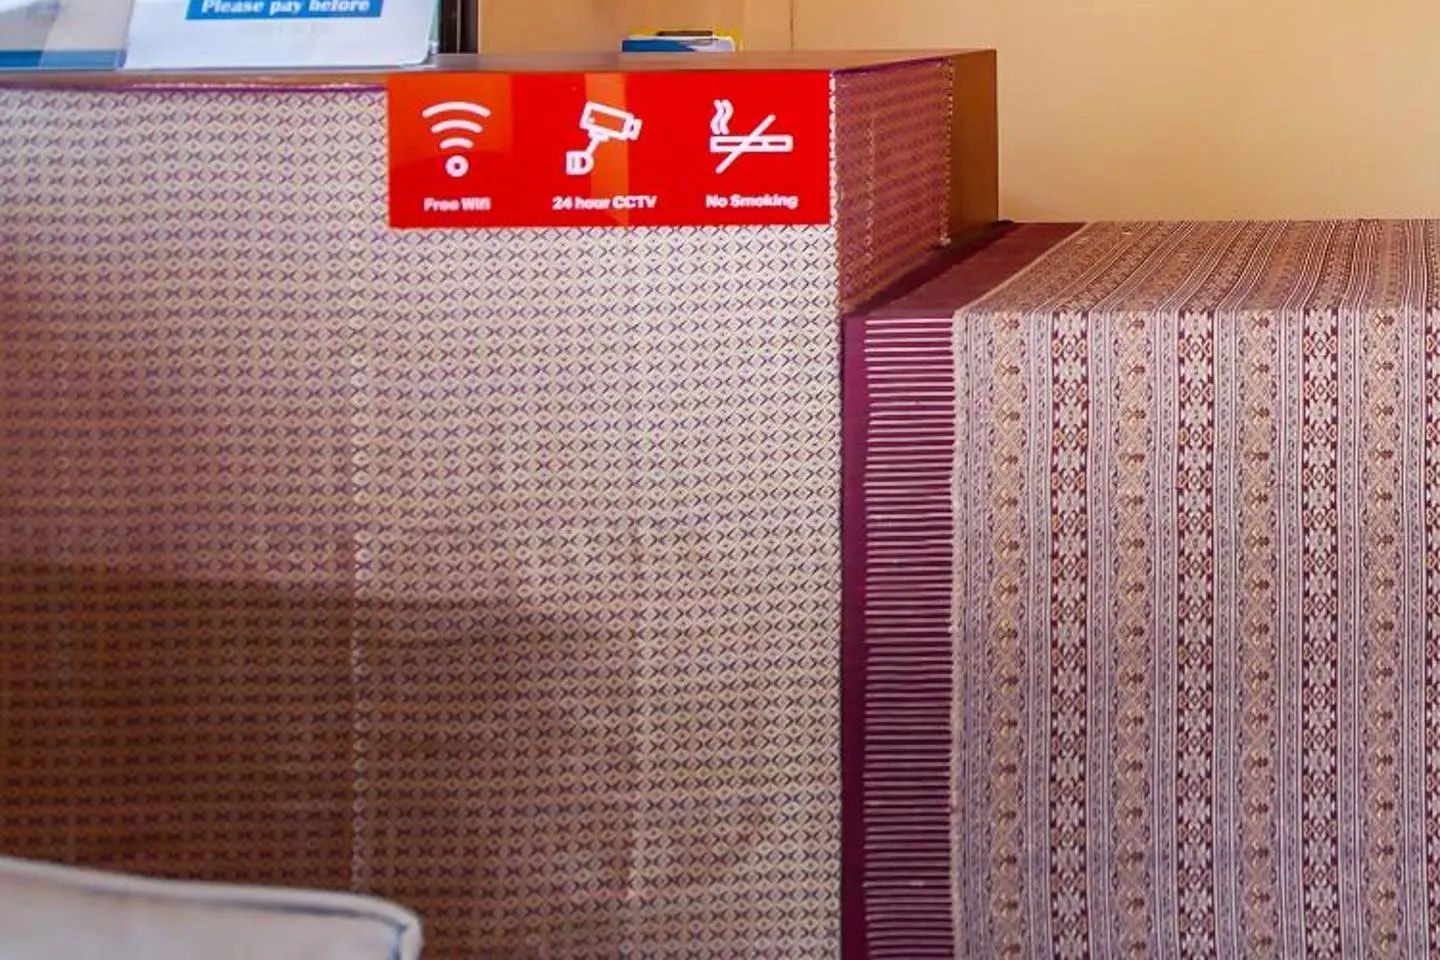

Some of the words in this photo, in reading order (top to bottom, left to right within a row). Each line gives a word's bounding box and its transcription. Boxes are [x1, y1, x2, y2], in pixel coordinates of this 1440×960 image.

[269, 1, 302, 16] pay
[423, 196, 458, 211] Free
[460, 196, 491, 211] Wifi
[552, 195, 573, 210] 24
[574, 195, 610, 210] hour
[612, 195, 657, 210] CCTV
[706, 194, 728, 208] No
[730, 193, 799, 209] Smoking
